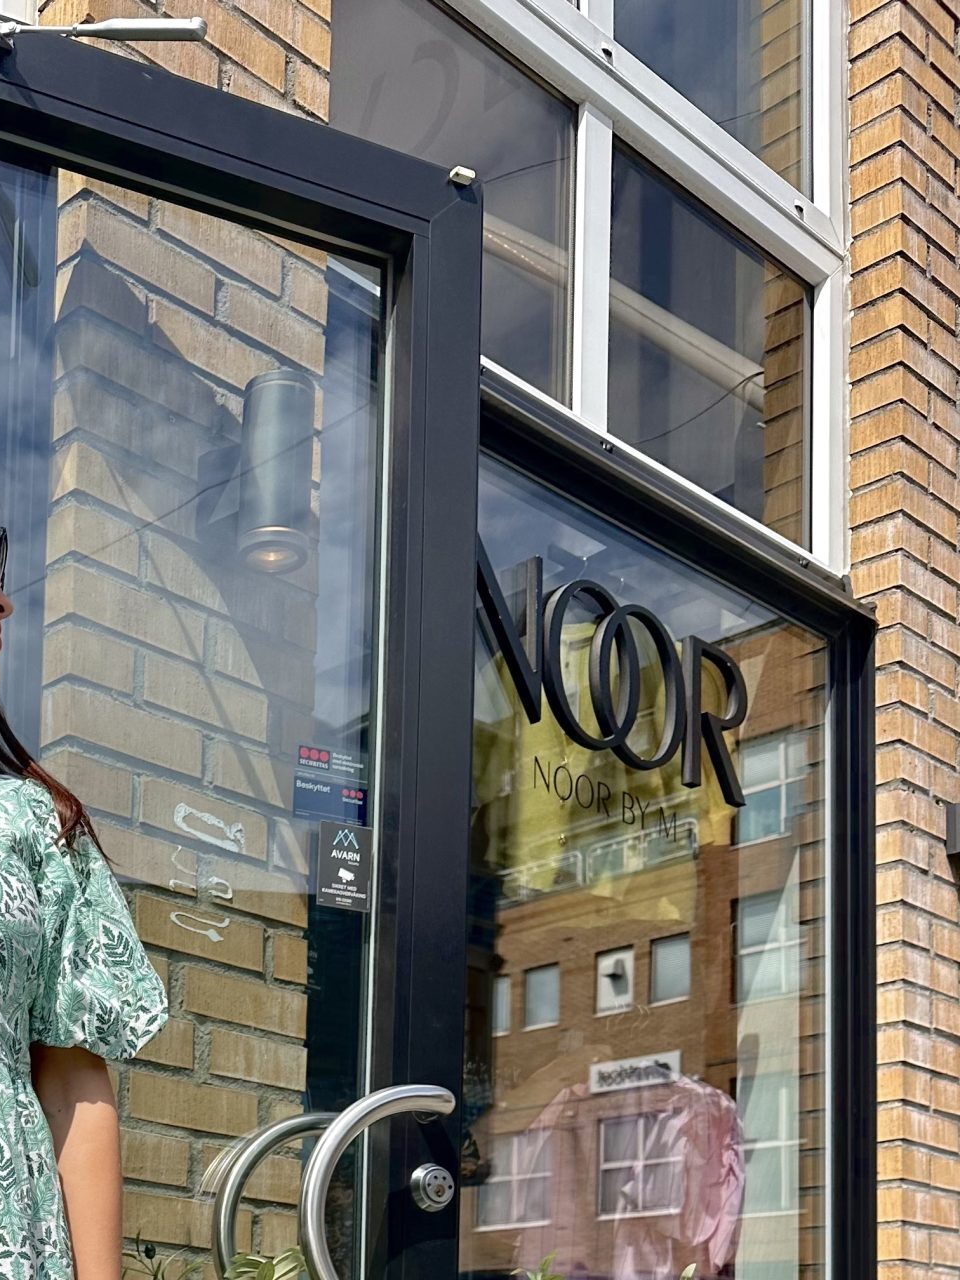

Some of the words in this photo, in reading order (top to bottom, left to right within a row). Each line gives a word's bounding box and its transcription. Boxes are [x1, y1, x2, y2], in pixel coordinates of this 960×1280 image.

[476, 531, 748, 809] NOOR
[296, 780, 330, 793] Beskyttet
[533, 756, 611, 817] NOOR
[622, 792, 649, 831] BY
[658, 806, 678, 842] M
[331, 849, 360, 862] AVARN
